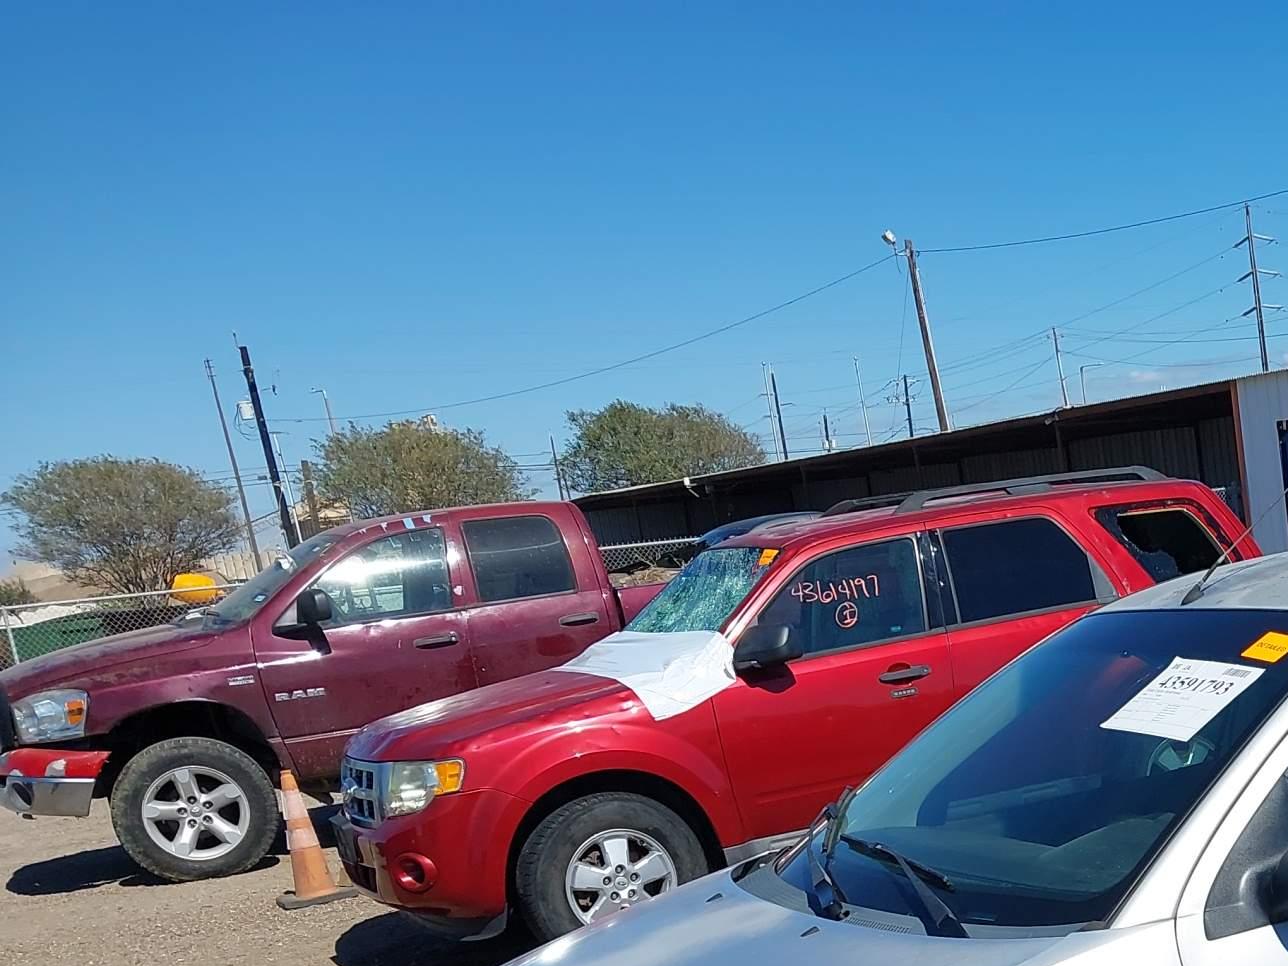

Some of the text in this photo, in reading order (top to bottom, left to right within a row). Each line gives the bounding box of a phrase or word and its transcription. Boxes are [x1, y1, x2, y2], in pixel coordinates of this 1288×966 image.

[791, 574, 879, 604] 43614197
[274, 687, 327, 702] RAM
[1158, 675, 1235, 696] 43591793
